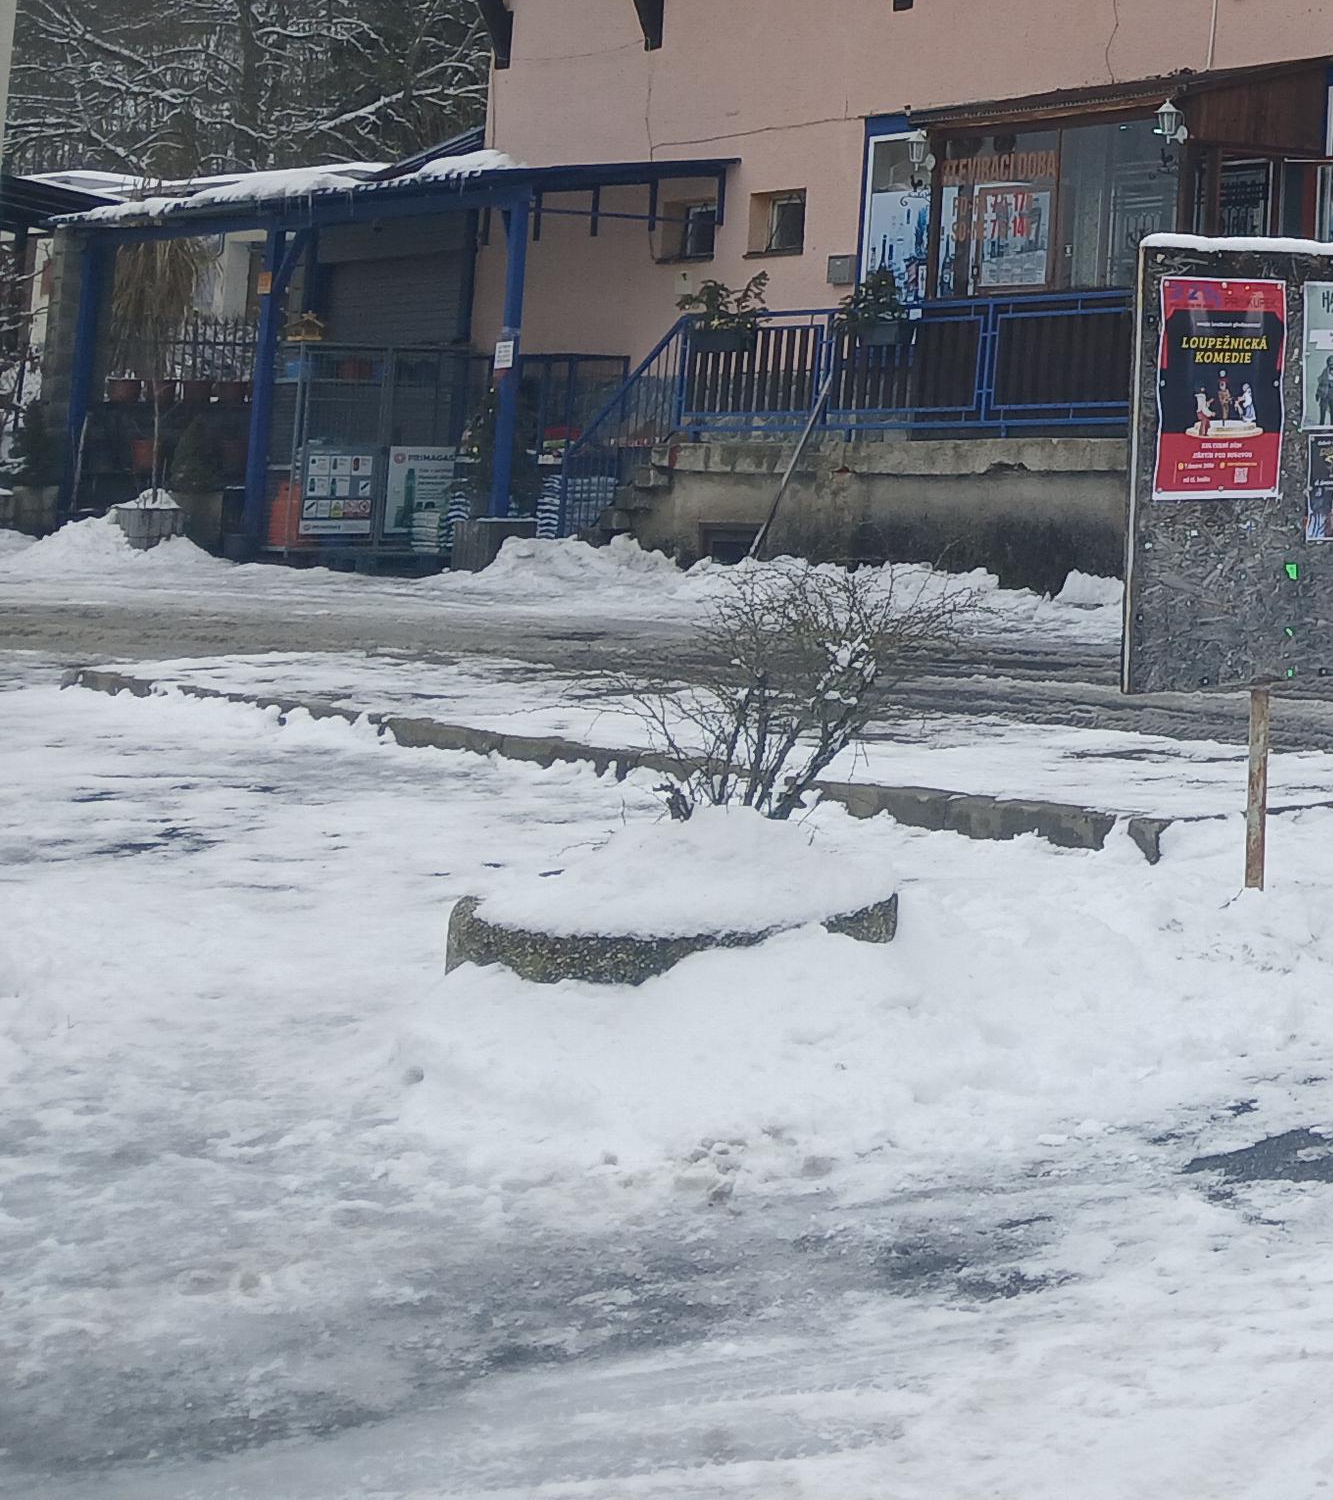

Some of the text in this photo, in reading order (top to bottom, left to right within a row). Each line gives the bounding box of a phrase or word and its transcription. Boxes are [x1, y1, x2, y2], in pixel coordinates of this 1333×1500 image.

[1018, 150, 1057, 180] DOBA
[1181, 335, 1268, 349] LOUPEŽNICKÁ
[1195, 351, 1252, 363] KOMEDIE
